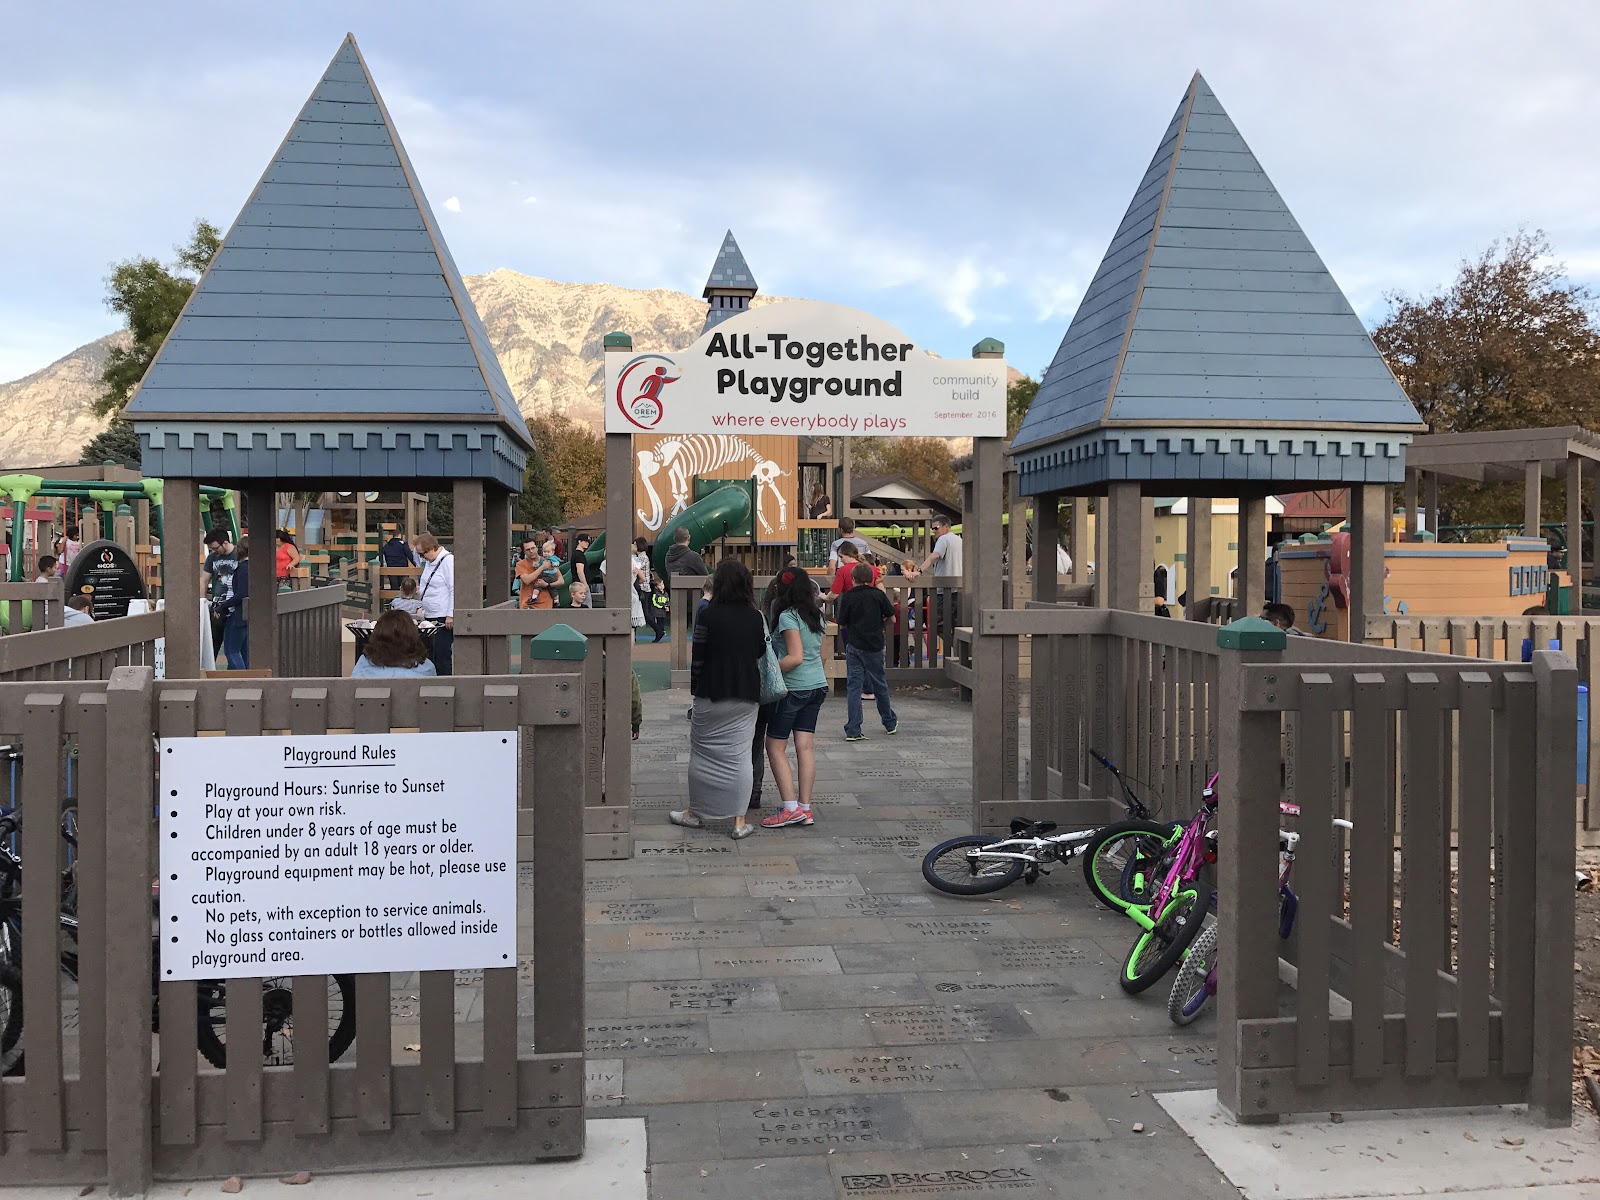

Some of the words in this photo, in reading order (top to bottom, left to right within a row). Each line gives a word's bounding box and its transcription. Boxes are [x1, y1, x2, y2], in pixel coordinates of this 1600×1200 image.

[705, 333, 913, 367] All-Together
[717, 368, 902, 403] Playground
[932, 375, 998, 388] community
[952, 389, 980, 401] build
[712, 413, 765, 427] where
[770, 414, 859, 431] everybody
[864, 413, 907, 431] plays
[934, 412, 973, 420] September
[977, 411, 997, 419] 2016
[285, 746, 356, 764] Playground
[363, 745, 395, 759] Rules
[206, 782, 278, 801] Playground
[285, 782, 326, 795] Hours:
[333, 780, 379, 794] Sunrise
[385, 782, 397, 793] to
[403, 778, 445, 793] Sunset
[206, 804, 232, 822] Play
[238, 806, 250, 817] at
[256, 808, 283, 821] your
[289, 807, 313, 816] own
[320, 801, 345, 815] risk.
[206, 825, 260, 839] Children
[267, 823, 303, 837] under
[309, 822, 316, 836] 8
[321, 826, 354, 840] years
[360, 821, 372, 835] of
[378, 825, 400, 838] age
[406, 821, 437, 833] must
[442, 819, 456, 833] be
[192, 844, 279, 863] accompanied
[285, 844, 299, 861] by
[305, 848, 319, 857] an
[325, 842, 358, 856] adult
[365, 841, 378, 855] 18
[384, 845, 417, 859] years
[423, 845, 435, 854] or
[440, 839, 473, 853] older.
[206, 865, 279, 884] Playground
[285, 865, 353, 882] equipment
[359, 867, 384, 879] may
[390, 861, 404, 875] be
[410, 861, 433, 877] hot,
[440, 860, 479, 877] please
[486, 862, 506, 872] use
[192, 891, 245, 904] caution.
[206, 909, 224, 922] No
[231, 910, 260, 924] pets,
[267, 906, 293, 920] with
[299, 905, 360, 922] exception
[366, 906, 378, 917] to
[384, 906, 427, 916] service
[433, 900, 485, 915] animals.
[207, 929, 225, 943] No
[231, 928, 263, 946] glass
[269, 927, 336, 941] containers
[342, 929, 354, 938] or
[360, 923, 402, 938] bottles
[408, 921, 455, 936] allowed
[461, 919, 497, 934] inside
[193, 948, 265, 968] playground
[272, 952, 303, 961] area.
[669, 998, 737, 1008] FELT
[753, 1106, 872, 1118] Celebrate
[759, 1131, 882, 1146] Preschool
